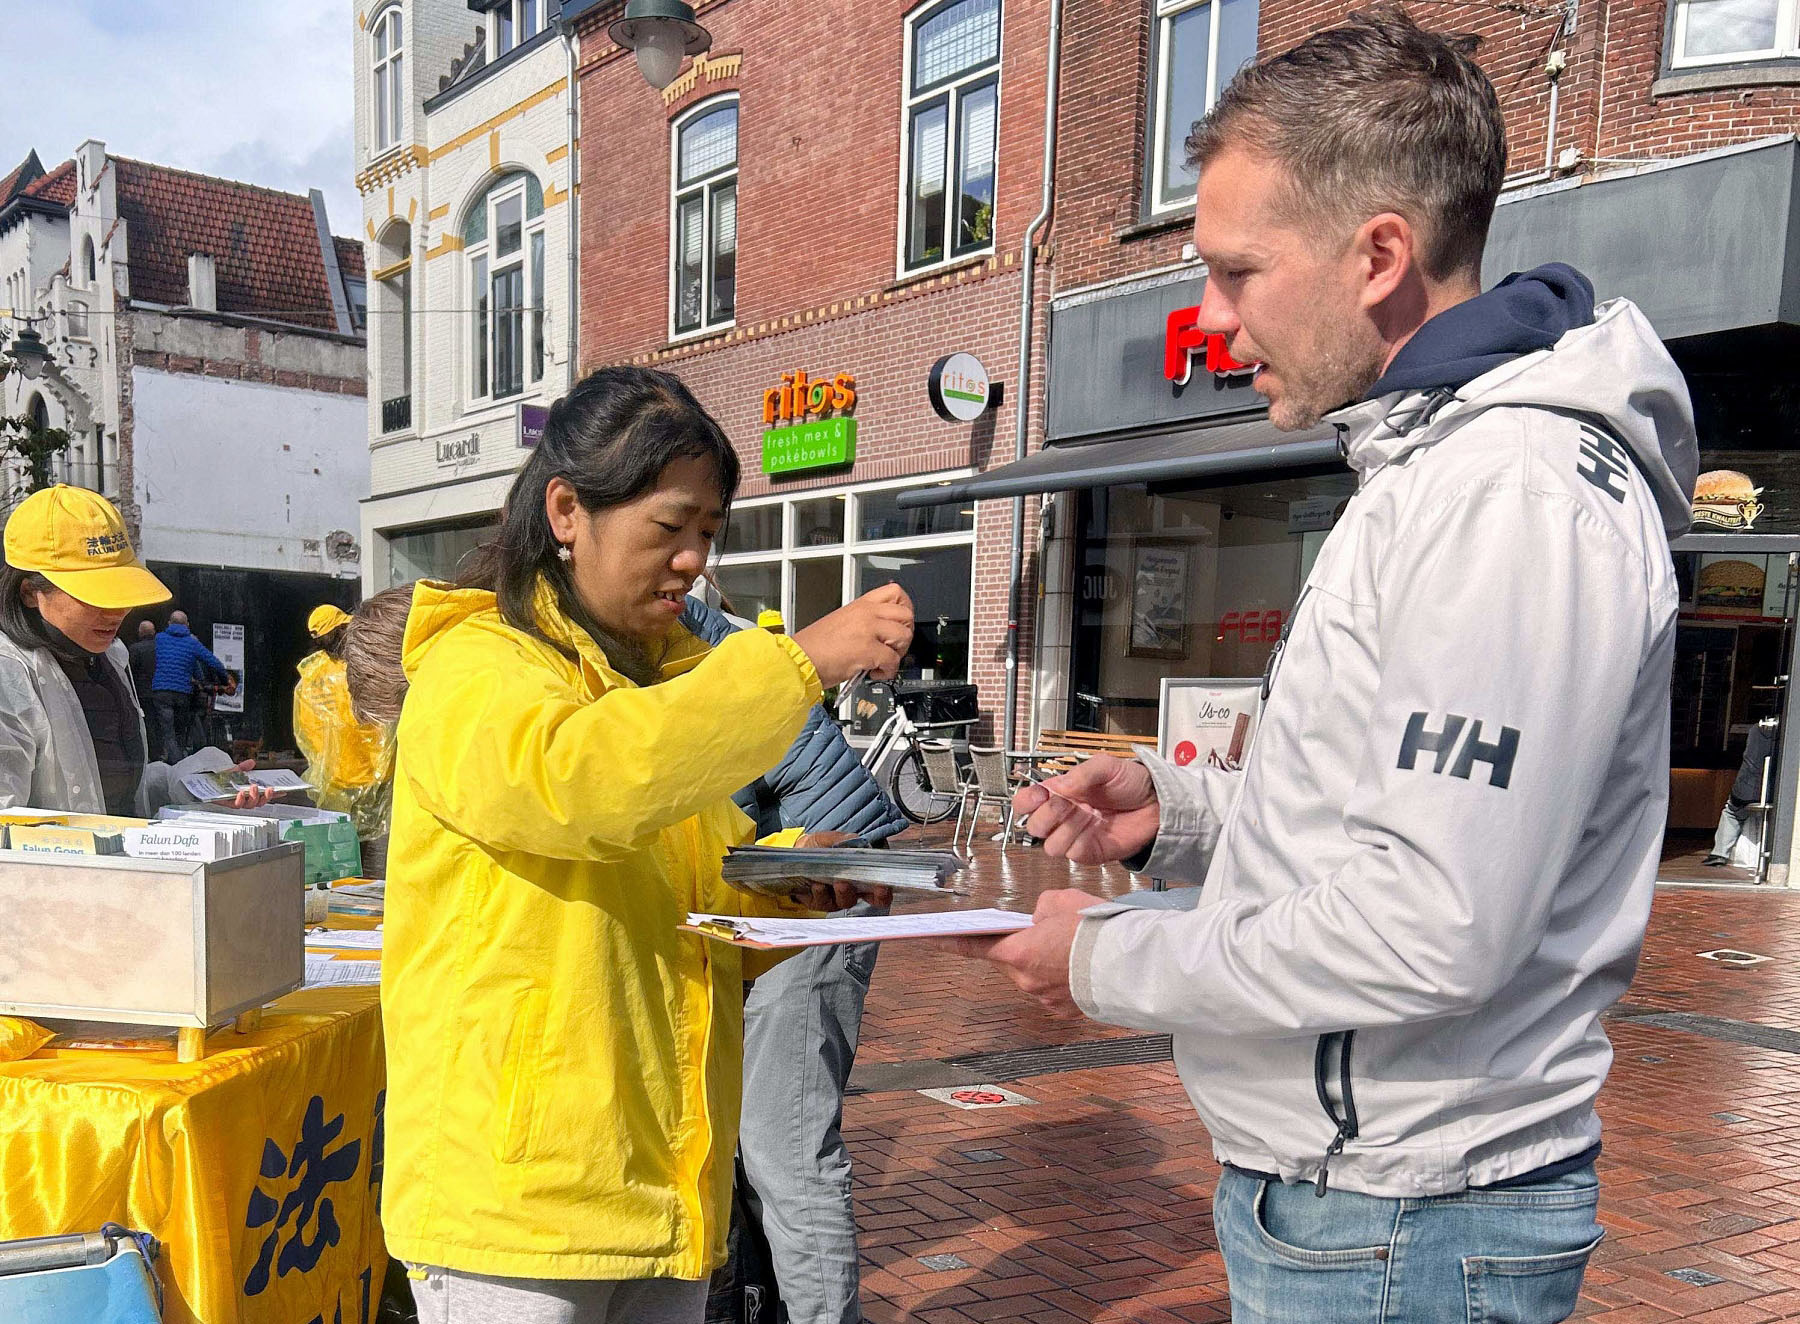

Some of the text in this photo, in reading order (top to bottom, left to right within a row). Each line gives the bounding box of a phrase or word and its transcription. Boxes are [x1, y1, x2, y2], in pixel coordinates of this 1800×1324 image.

[763, 369, 855, 424] ritos
[943, 371, 986, 396] ritos
[436, 432, 480, 462] Lucardi
[767, 422, 841, 449] fresh mex &
[770, 443, 838, 469] pokébowls
[1217, 610, 1289, 643] FEB
[140, 834, 199, 847] Falun Dafa
[244, 1088, 386, 1297] 法
